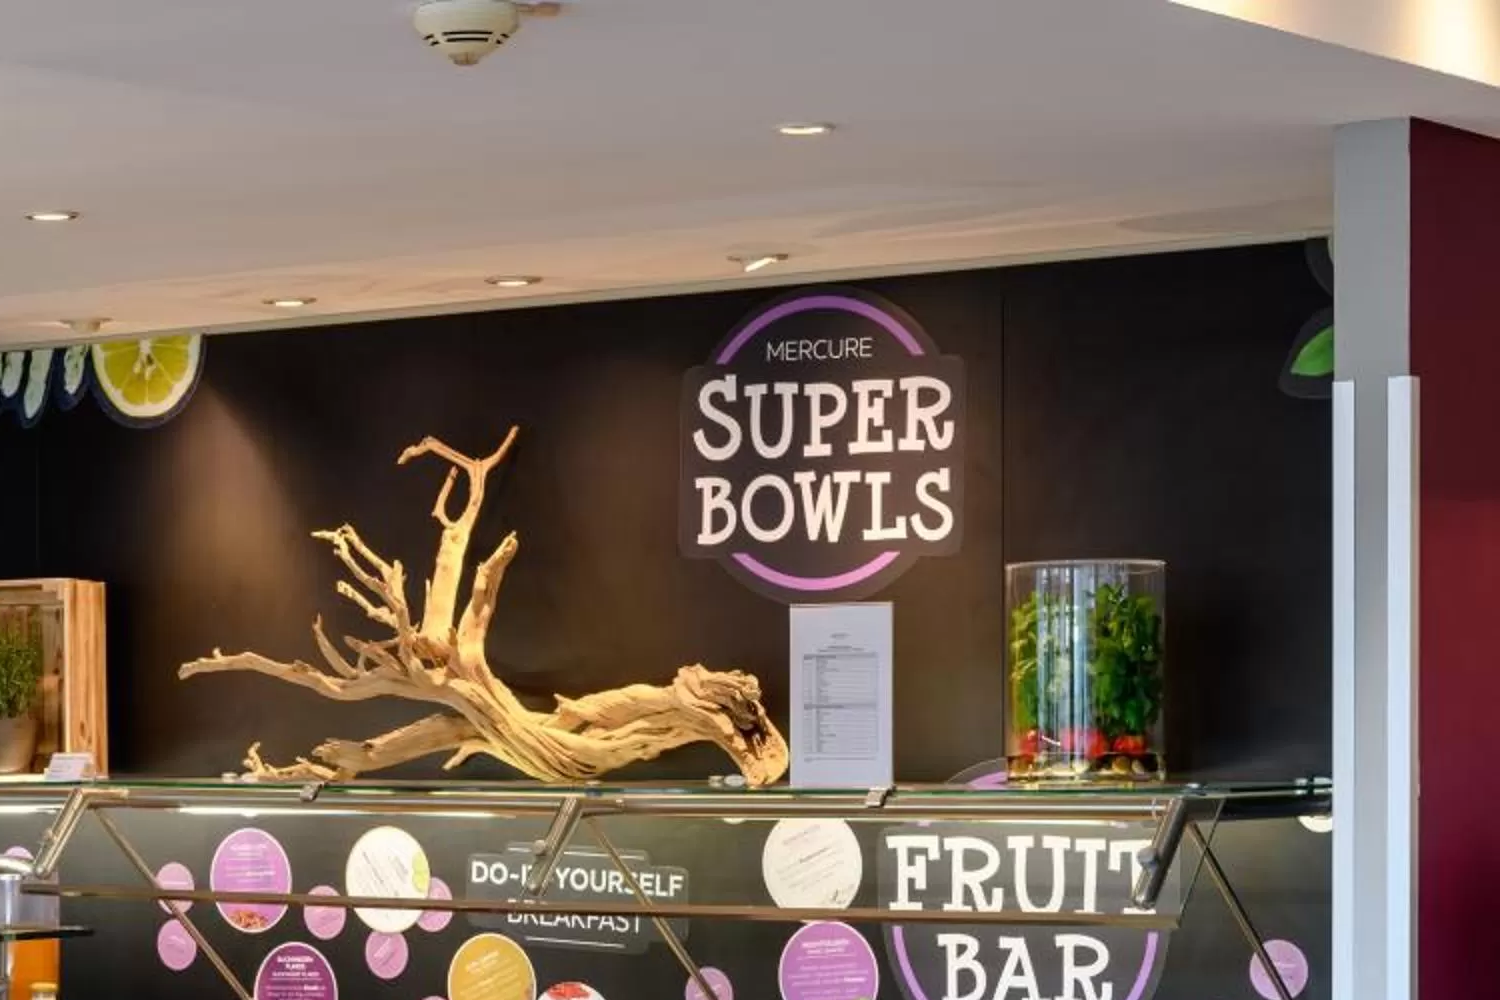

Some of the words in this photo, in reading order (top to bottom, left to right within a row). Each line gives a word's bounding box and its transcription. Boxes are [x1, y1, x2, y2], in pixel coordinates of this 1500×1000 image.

[766, 338, 873, 362] MERCURE
[693, 374, 955, 461] SUPER
[695, 467, 954, 545] BOWLS
[471, 860, 541, 889] DO-I
